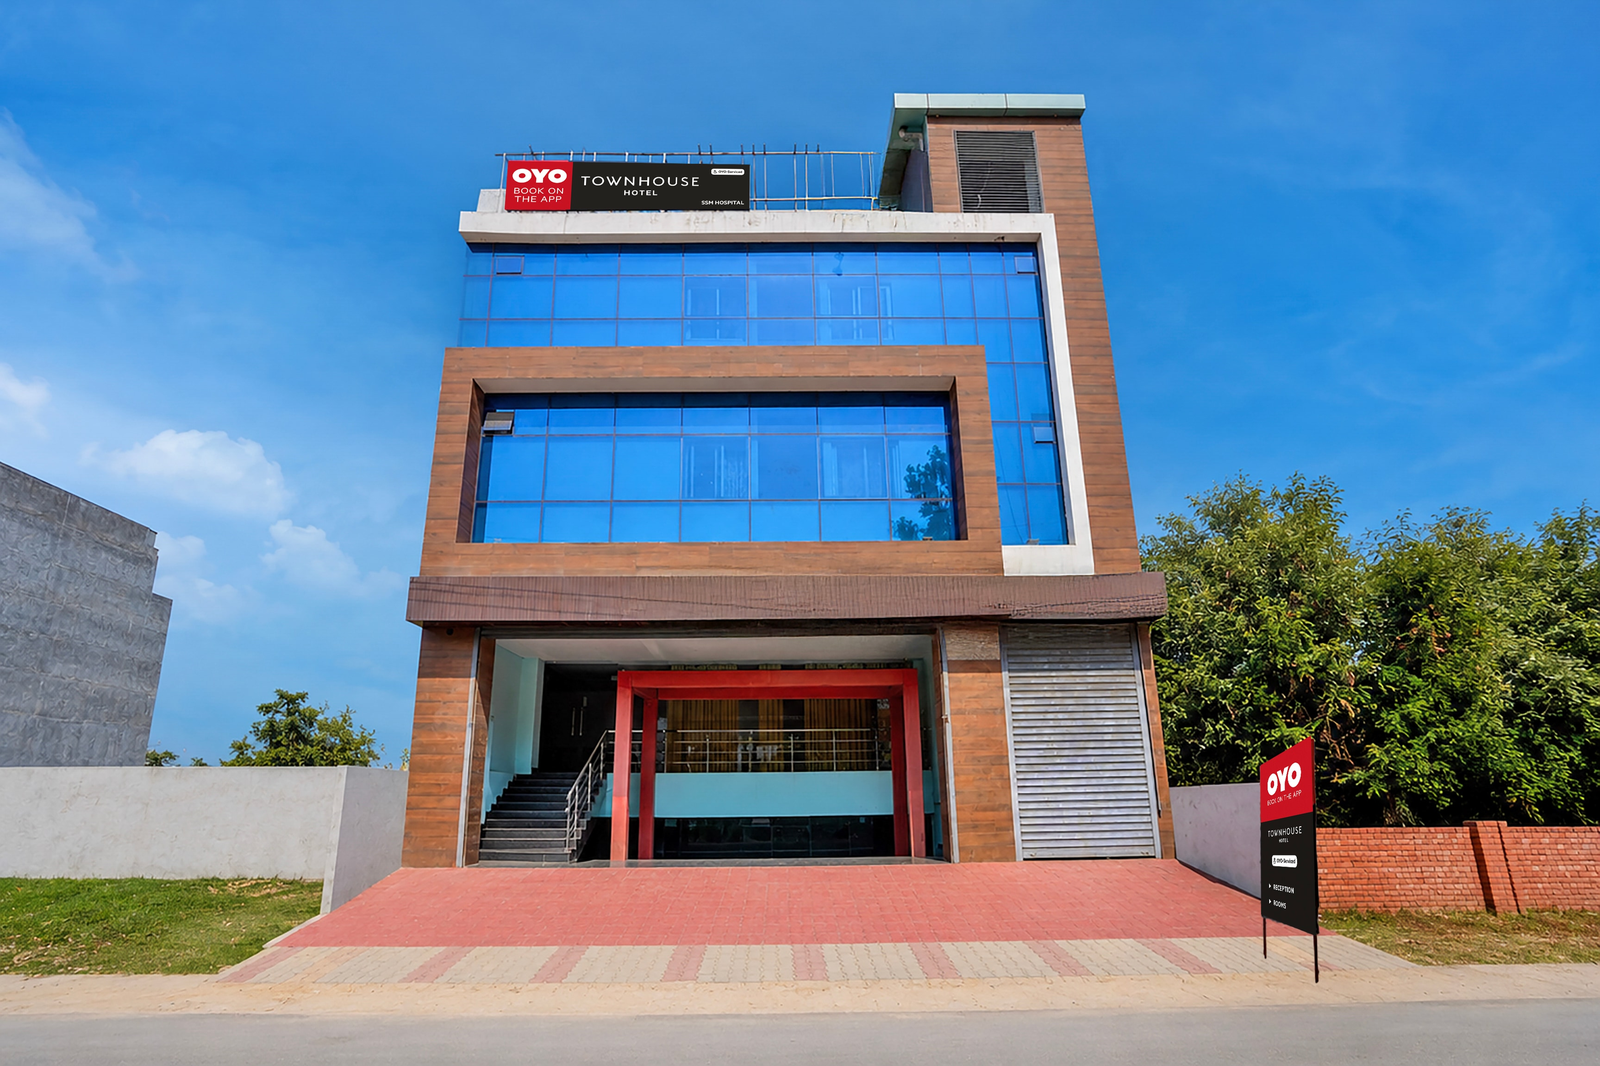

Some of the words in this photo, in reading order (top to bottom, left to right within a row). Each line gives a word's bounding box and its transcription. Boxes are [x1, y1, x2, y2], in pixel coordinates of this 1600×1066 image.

[512, 168, 567, 184] OYO
[580, 176, 700, 187] TOWNHOUSE
[513, 187, 544, 195] BOOK
[547, 187, 564, 195] ON
[1267, 762, 1302, 796] OYO
[1266, 798, 1276, 806] BOOK
[1293, 789, 1302, 798] APP
[1268, 825, 1302, 837] TOWNHOUSE
[1273, 884, 1294, 894] RECEPTION
[1273, 900, 1287, 910] ROOMS
